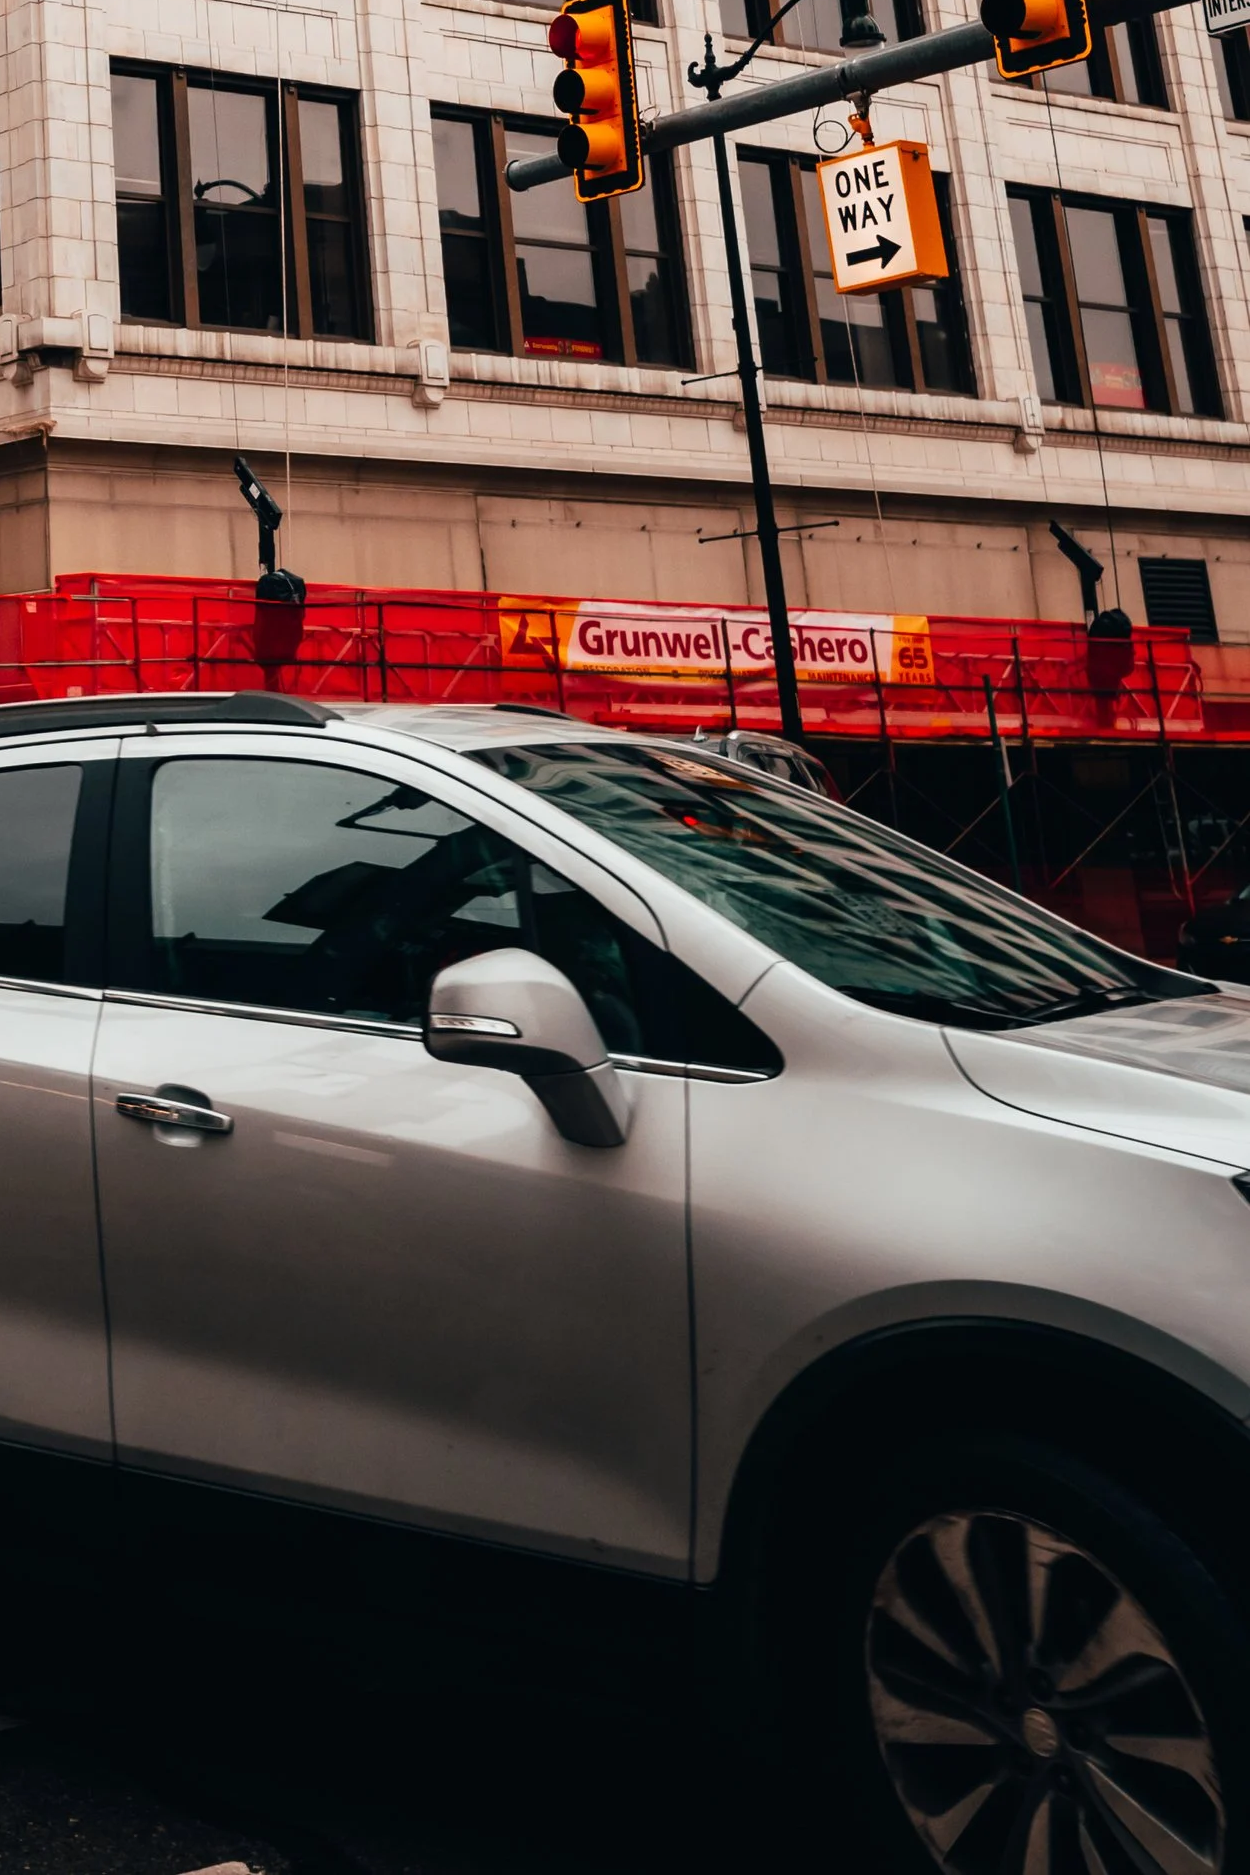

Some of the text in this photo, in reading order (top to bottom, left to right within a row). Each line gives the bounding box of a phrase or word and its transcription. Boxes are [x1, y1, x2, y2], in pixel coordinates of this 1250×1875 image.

[835, 159, 890, 198] ONE
[837, 194, 894, 234] WAY
[578, 620, 868, 664] Grunwel-Cahero
[898, 647, 928, 670] 65
